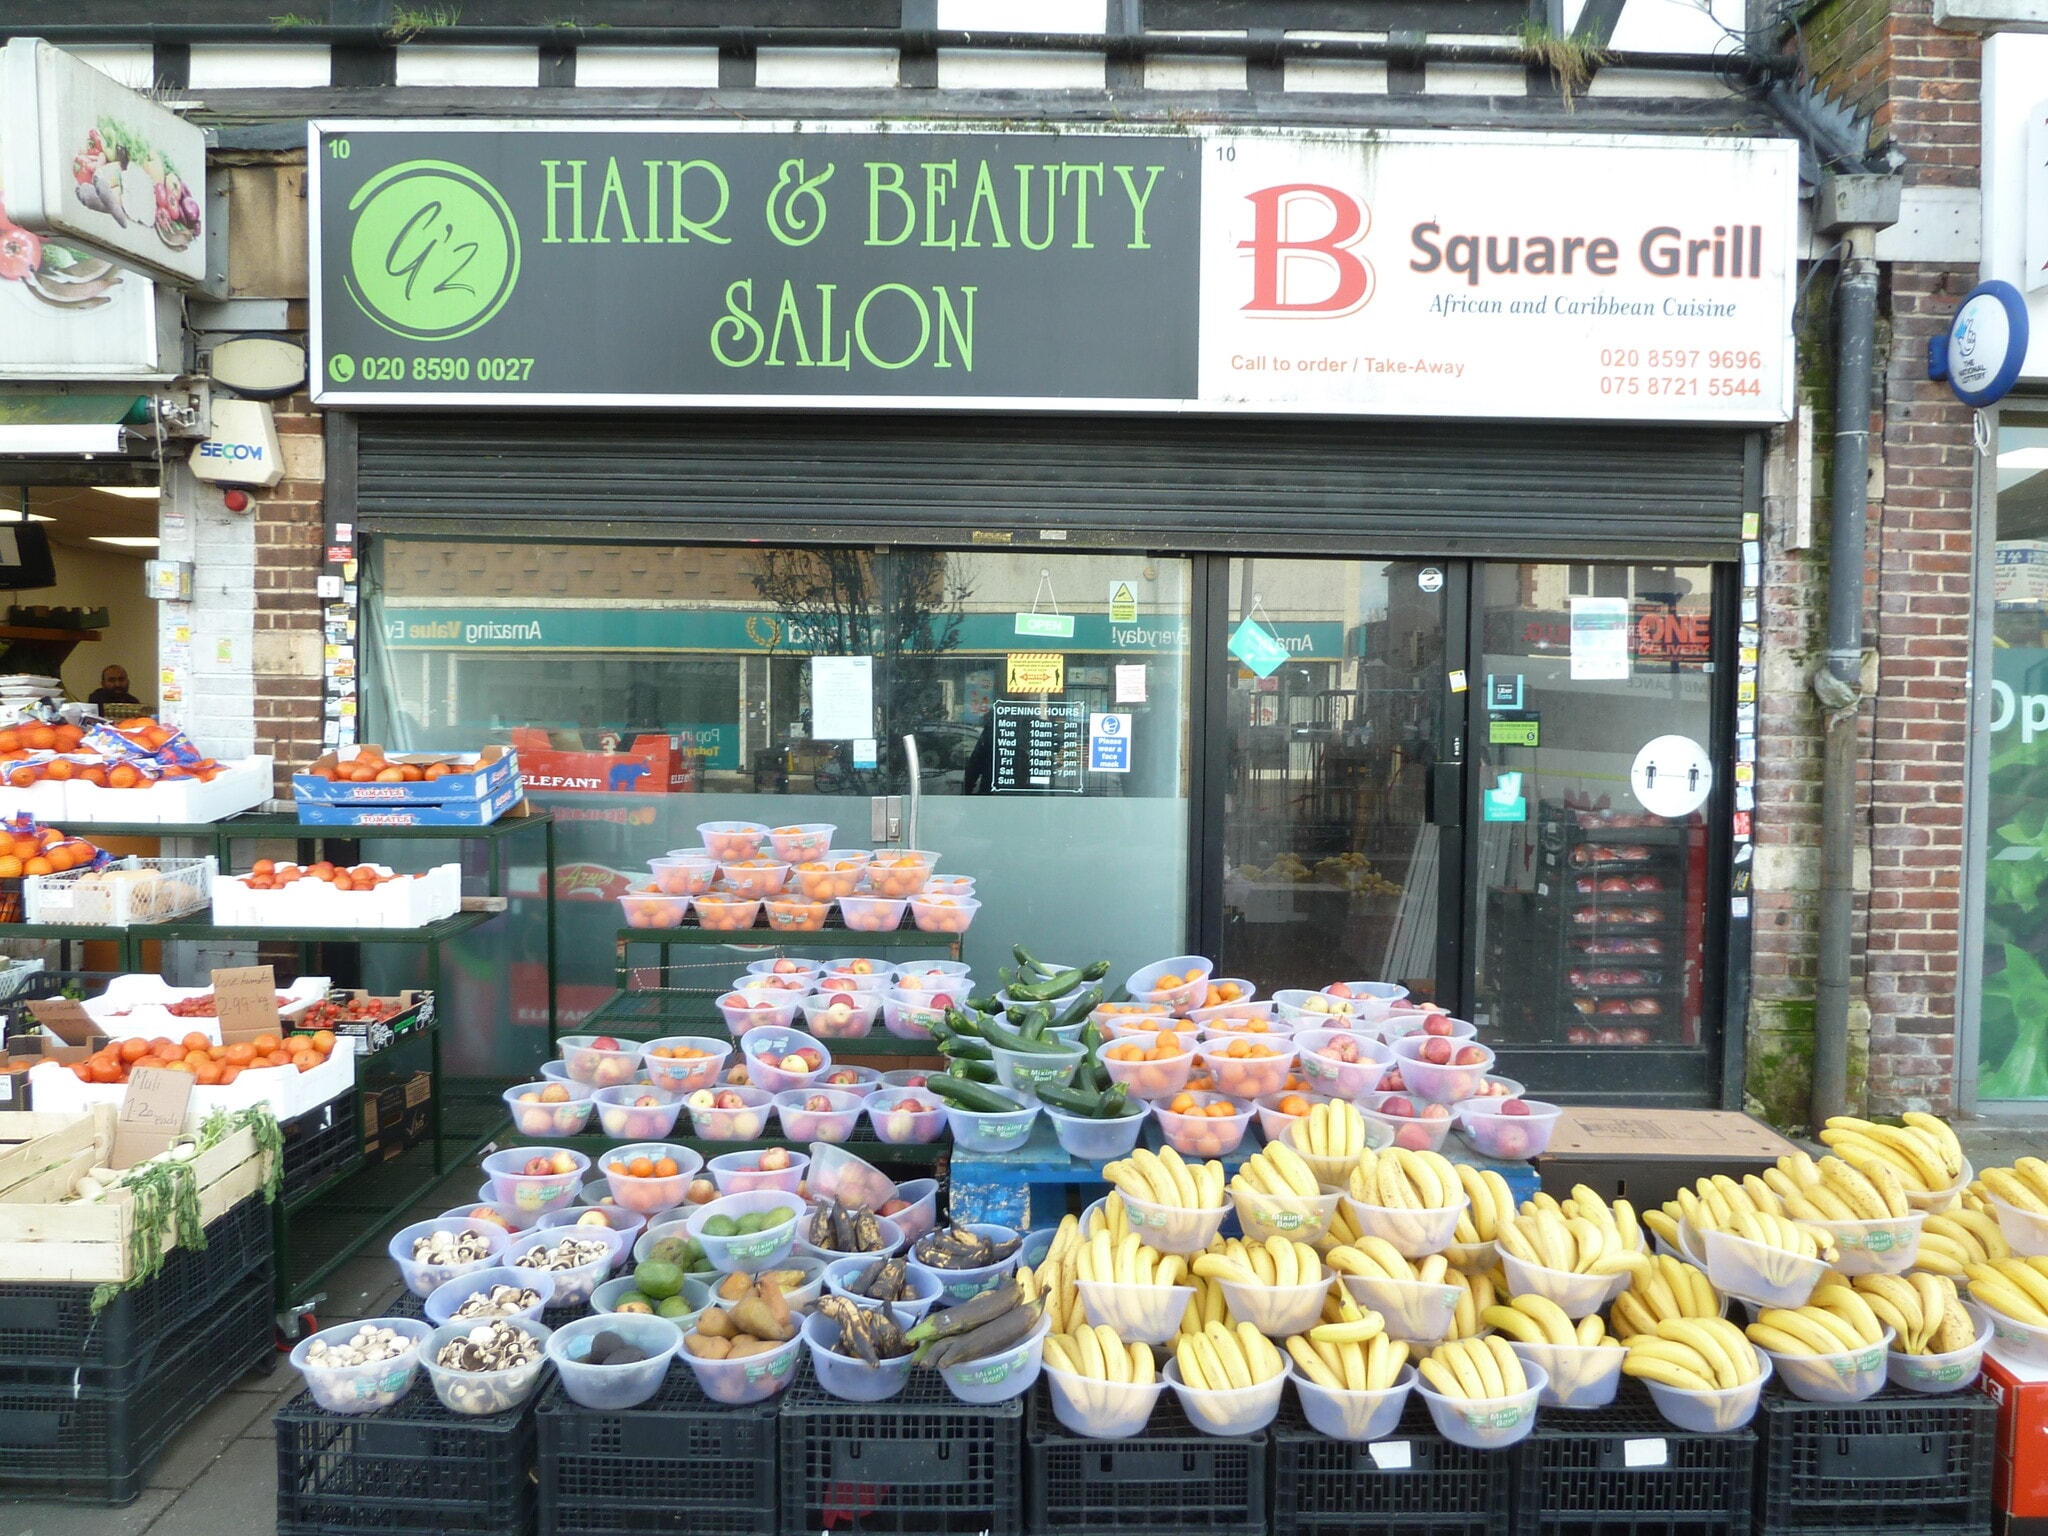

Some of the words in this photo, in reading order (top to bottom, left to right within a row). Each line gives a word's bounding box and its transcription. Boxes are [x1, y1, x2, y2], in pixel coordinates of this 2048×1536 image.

[328, 139, 351, 159] 10
[1214, 145, 1237, 163] 10
[540, 156, 732, 246] HAIR
[765, 157, 836, 247] &
[862, 157, 1165, 252] BEAUTY
[1236, 183, 1377, 320] B
[1408, 219, 1620, 287] Square
[1638, 223, 1764, 280] Grill
[1428, 293, 1504, 317] African
[1508, 294, 1548, 316] and
[1553, 295, 1656, 318] Caribbean
[1661, 296, 1738, 319] Cuisine
[709, 278, 978, 372] SALON
[1231, 353, 1268, 373] Call
[1273, 354, 1291, 373] to
[1297, 354, 1348, 374] order
[1365, 356, 1466, 379] Take-Away
[1599, 348, 1640, 369] 020
[1646, 348, 1701, 370] 8597
[1706, 349, 1762, 371] 9696
[361, 356, 405, 381] 020
[411, 357, 470, 382] 8590
[476, 357, 535, 383] 0027
[1599, 375, 1640, 396] 075
[1646, 376, 1701, 398] 8721
[1706, 377, 1762, 398] 5544
[200, 441, 263, 461] SECOM
[1026, 618, 1064, 632] OPEN
[1638, 613, 1711, 643] ONE
[1638, 644, 1711, 655] DELIVERY
[996, 706, 1041, 716] OPENING
[1044, 706, 1080, 717] HOURS
[998, 720, 1017, 728] Mon
[1030, 720, 1052, 728] 10am
[999, 729, 1015, 737] Tue
[1030, 730, 1052, 738] 10am
[997, 739, 1017, 747] Wed
[1030, 739, 1052, 747] 10am
[1097, 737, 1122, 745] Please
[998, 748, 1015, 756] Thu
[1029, 749, 1051, 757] 10am
[1101, 752, 1118, 760] face
[1001, 758, 1013, 766] Fri
[1029, 759, 1051, 767] 10am
[999, 767, 1014, 775] Sat
[1029, 768, 1051, 776] 10am
[519, 774, 602, 789] ELEFANT
[997, 777, 1015, 785] Sun
[355, 789, 404, 798] TOMATES
[363, 815, 410, 824] TOMATES
[1030, 1069, 1058, 1077] Mixing
[1276, 1220, 1298, 1228] Bowl
[974, 1361, 1009, 1379] Mixing
